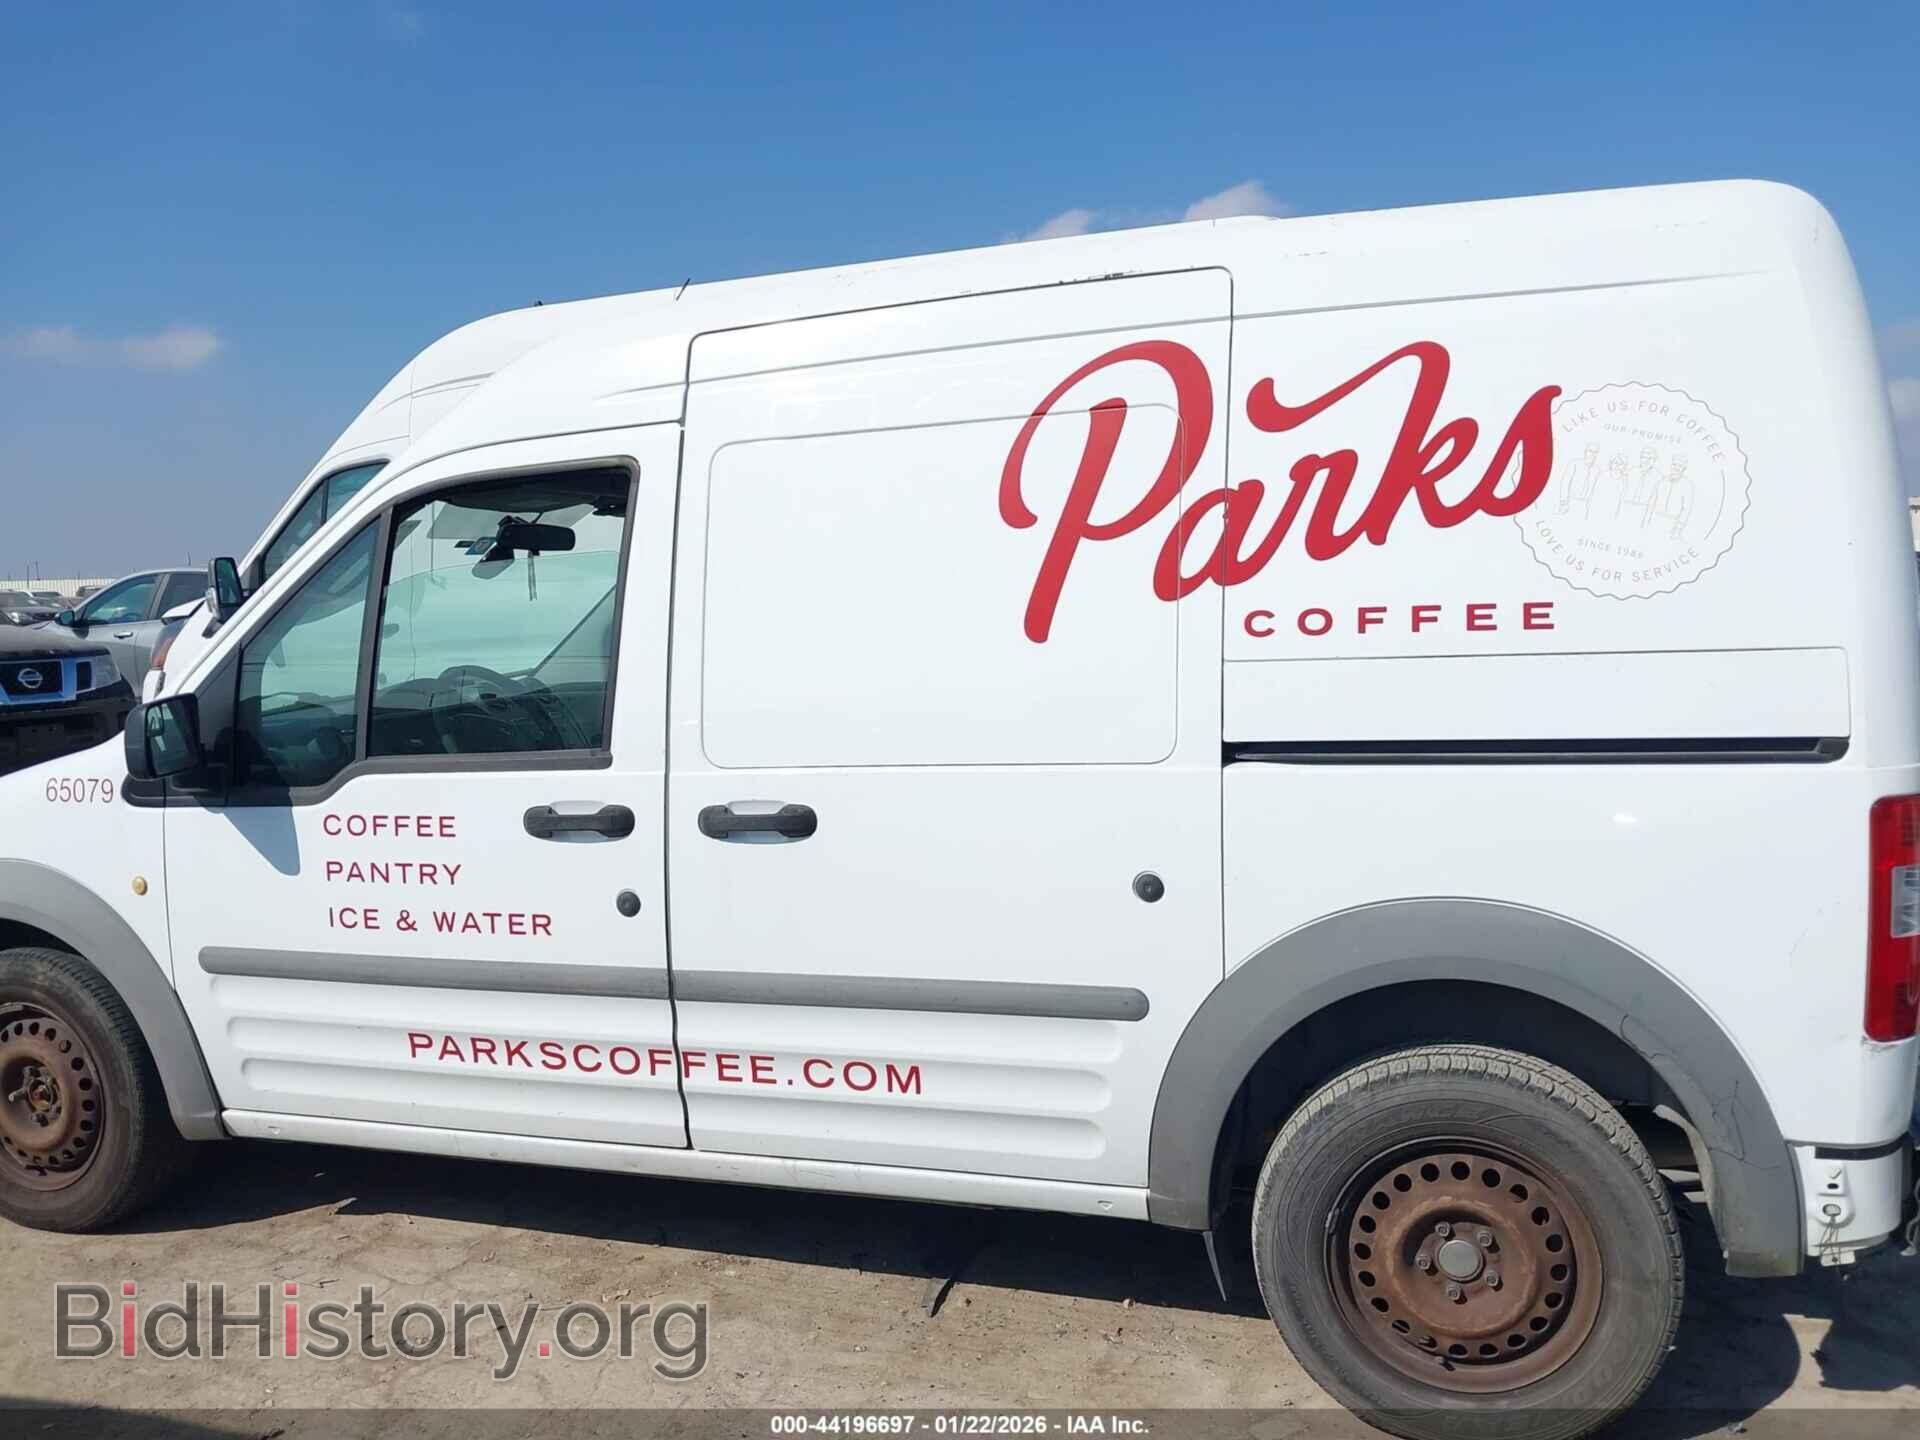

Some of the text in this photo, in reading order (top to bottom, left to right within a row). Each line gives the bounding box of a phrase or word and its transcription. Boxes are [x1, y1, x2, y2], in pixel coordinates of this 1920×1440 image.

[1562, 400, 1725, 462] LIKE US FOR COFFEE
[998, 340, 1562, 644] Parks
[1536, 519, 1699, 583] LOVE US FOR SERVICE
[1243, 602, 1555, 638] COFFEE
[45, 778, 114, 803] 65079
[322, 813, 457, 838] COFFEE
[325, 861, 462, 885] PANTRY
[328, 907, 553, 937] ICE & WATER
[408, 1032, 923, 1095] PARKSCOFFEE.COM
